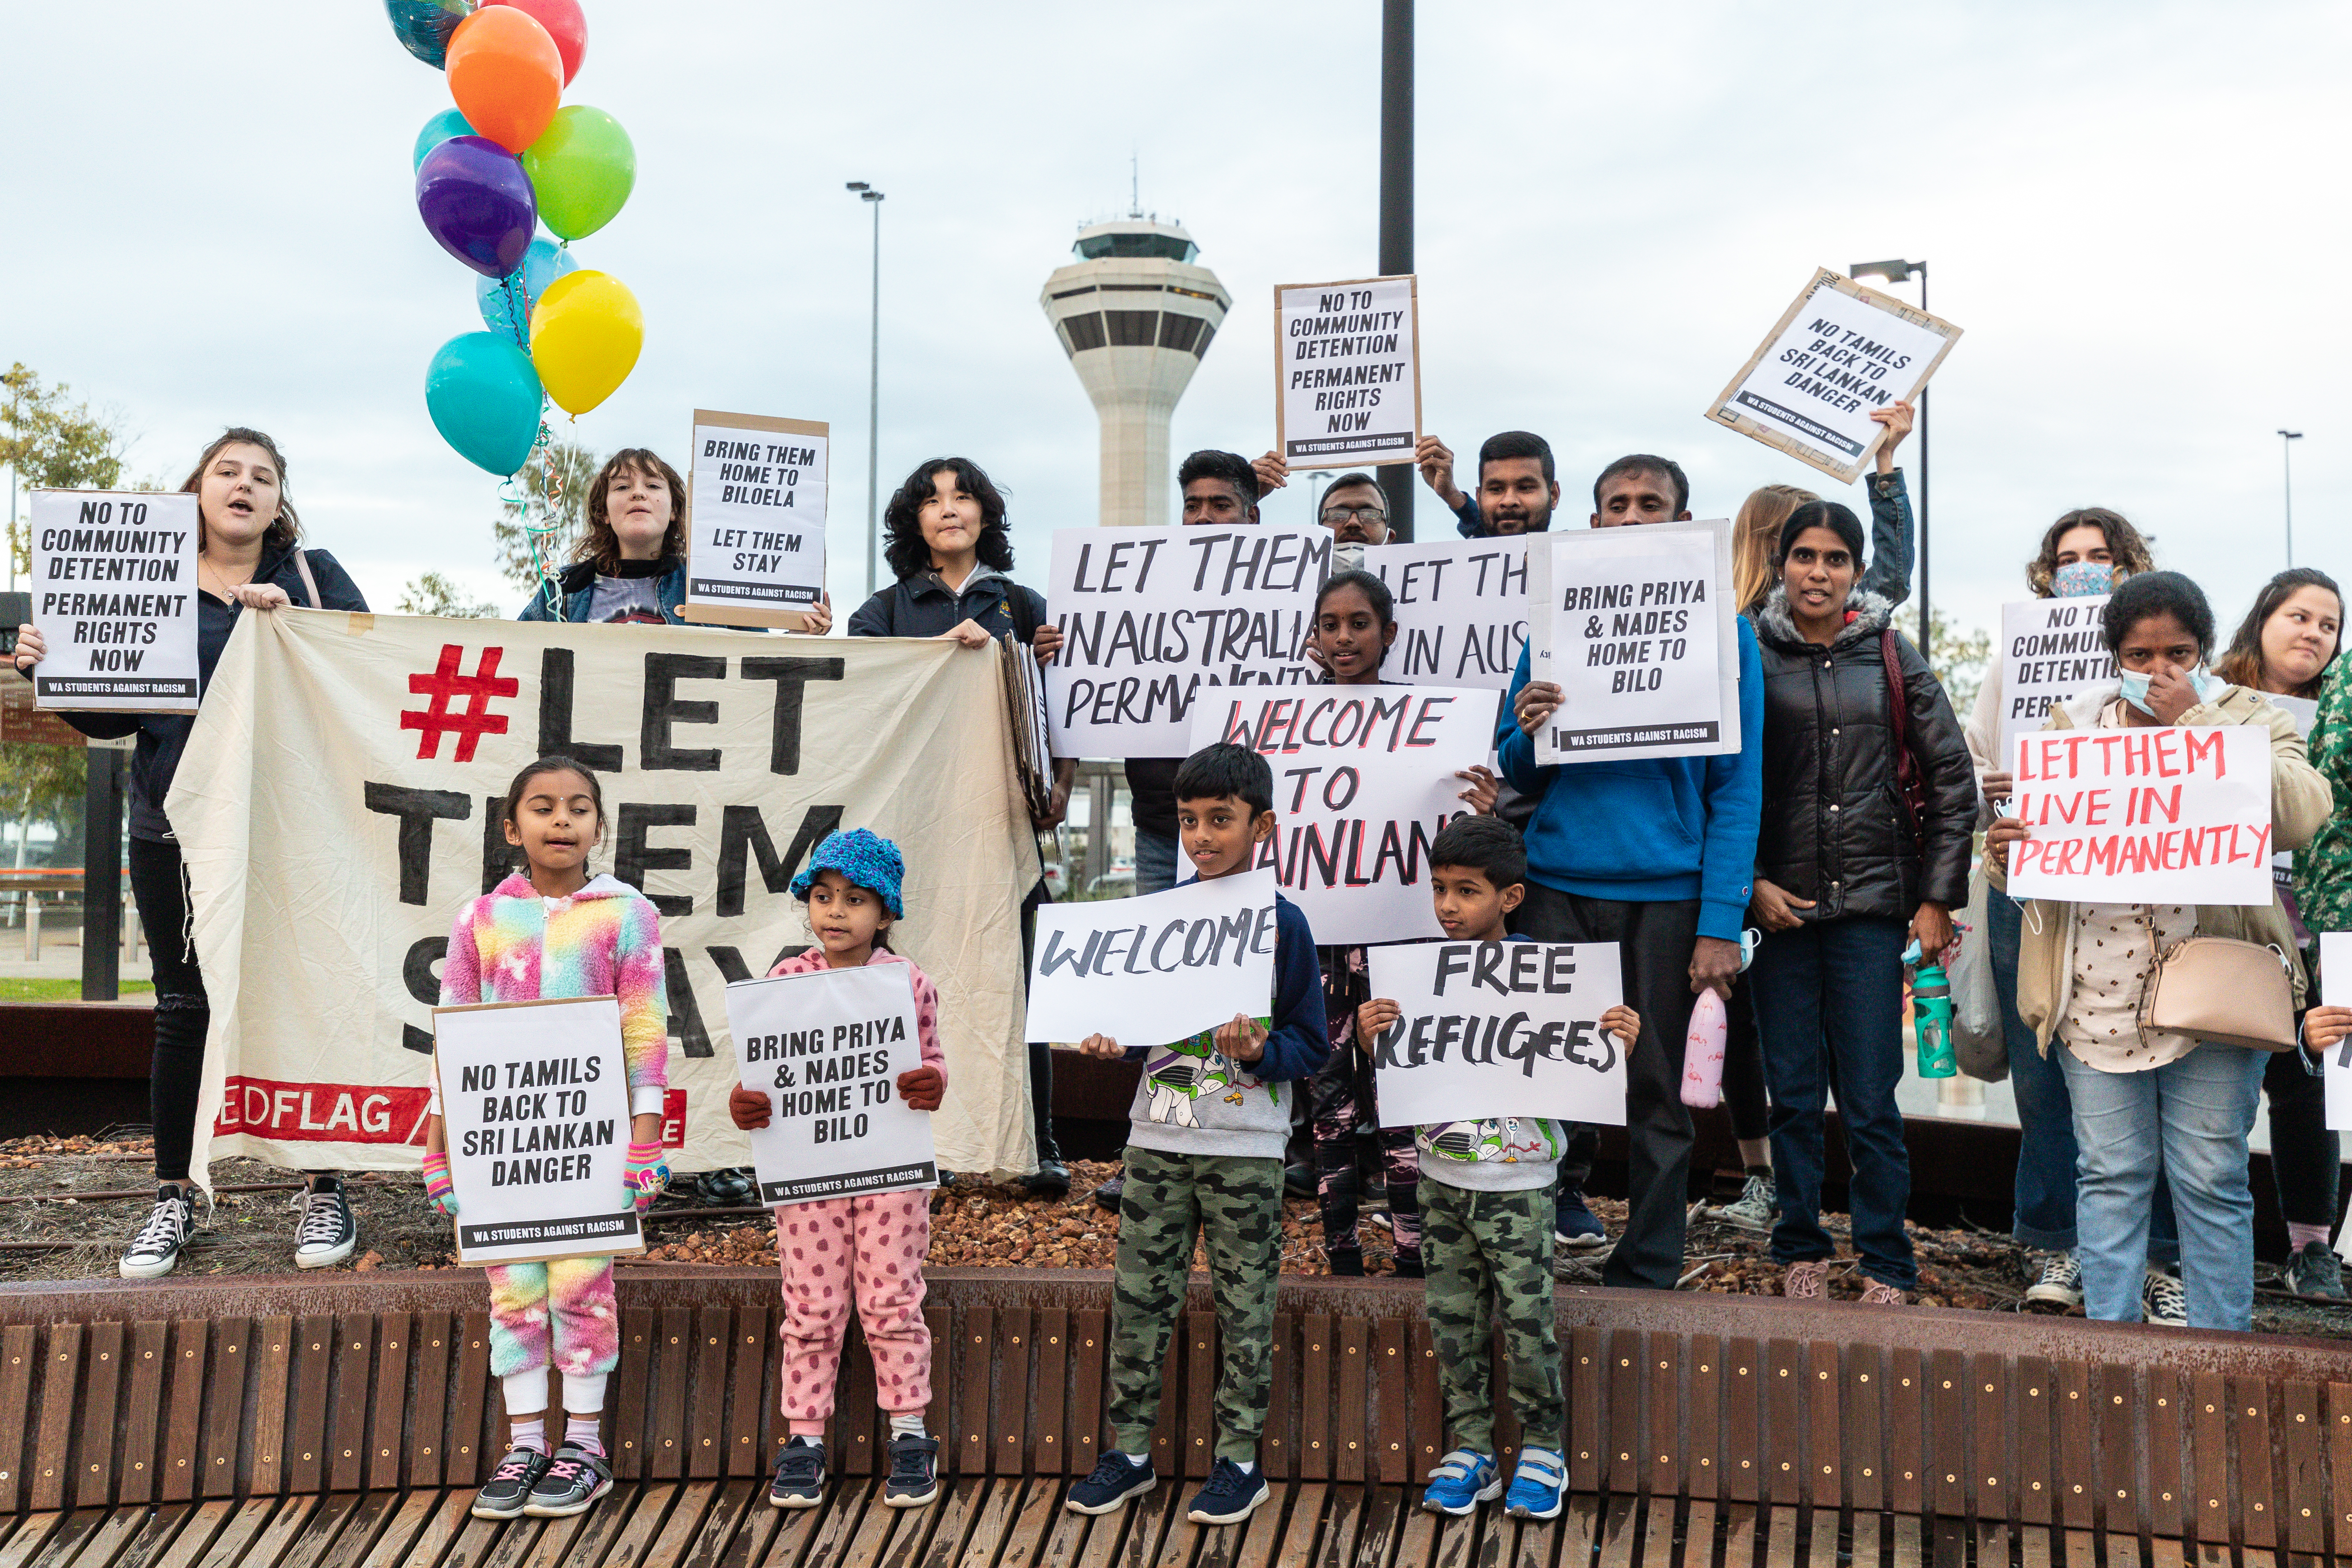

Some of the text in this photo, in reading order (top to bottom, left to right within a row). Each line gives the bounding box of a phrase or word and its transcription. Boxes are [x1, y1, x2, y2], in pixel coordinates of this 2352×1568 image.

[1320, 290, 1372, 313] NO TO
[1290, 311, 1403, 337] COMMUNITY
[1296, 334, 1398, 360] DETENTION
[1808, 318, 1840, 337] NO
[1839, 330, 1912, 370] TAMILS
[1808, 339, 1887, 379] BACK TO
[1292, 363, 1405, 389] PERMANENT
[1780, 349, 1892, 407] SRI LANKAN
[1316, 388, 1381, 411] RIGHTS
[1784, 368, 1861, 413] DANGER
[1327, 412, 1371, 433] NOW
[1747, 396, 1854, 451] WA STUDENTS AGAINST RACISM
[704, 440, 815, 466] BRING THEM
[1308, 442, 1345, 451] STUDENTS
[1346, 439, 1376, 449] AGAINST
[1377, 437, 1404, 446] RACISM
[720, 463, 798, 486] HOME TO
[722, 485, 793, 507] BILOELA
[79, 502, 147, 525] NO TO
[42, 529, 187, 553] COMMUNITY
[713, 529, 802, 552] LET THEM
[48, 557, 179, 581] DETENTION
[733, 553, 782, 573] STAY
[1073, 533, 1333, 595] LET THEM
[42, 593, 187, 617] PERMANENT
[698, 584, 813, 599] WA STUDENTS AGAINST RACISM
[1564, 580, 1705, 611] BRING PRIYA
[1584, 610, 1688, 638] & NADES
[2047, 606, 2078, 628] NO
[74, 622, 157, 644] RIGHTS
[2012, 631, 2109, 657] COMMUN
[89, 650, 144, 671] NOW
[1403, 626, 1443, 675] IN
[1587, 638, 1686, 666] HOME TO
[1612, 668, 1662, 693] BILO
[2018, 658, 2119, 684] DETENTIO
[49, 683, 185, 693] WA STUDENTS AGAINST RACISM
[1222, 694, 1457, 755] WELCOME
[1571, 728, 1707, 745] WA STUDENTS AGAINST RACISM
[1284, 765, 1360, 814] TO
[2019, 784, 2182, 827] LIVE IN
[1248, 810, 1468, 890] AINLAN
[2014, 824, 2271, 877] PERMANENTLY
[1039, 905, 1276, 978] WELCOME
[1433, 941, 1576, 997] FREE
[747, 1016, 905, 1062] BRING PRIYA
[1375, 1011, 1616, 1078] REFUGEES
[462, 1056, 600, 1092] NO TAMILS
[774, 1050, 888, 1088] & NADES
[483, 1090, 586, 1123] BACK TO
[782, 1080, 890, 1117] HOME TO
[463, 1119, 614, 1156] SRI LANKAN
[815, 1114, 867, 1143] BILO
[492, 1154, 591, 1186] DANGER
[775, 1169, 923, 1196] WA STUDENTS AGAINST RACISM
[473, 1220, 624, 1242] WA STUDENTS AGAINST RACISM
